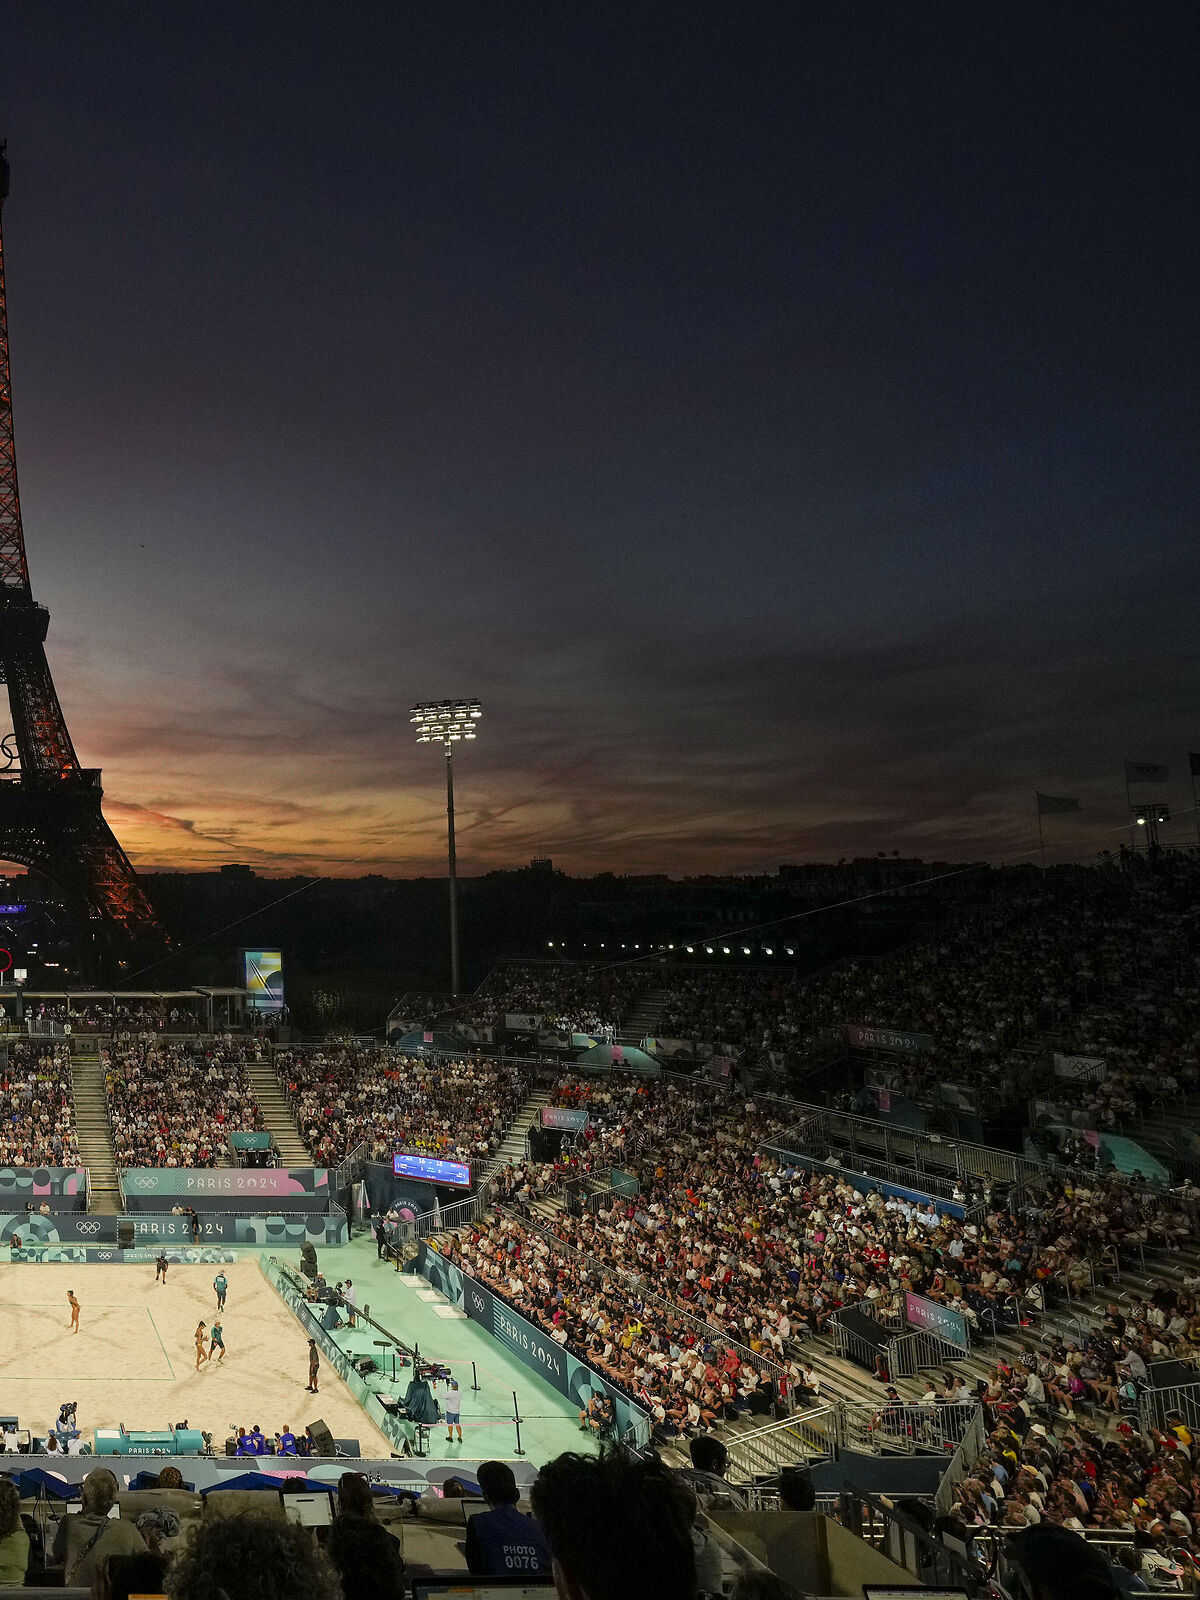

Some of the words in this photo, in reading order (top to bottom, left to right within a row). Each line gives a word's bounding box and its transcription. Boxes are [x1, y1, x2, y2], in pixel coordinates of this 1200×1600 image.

[187, 1178, 231, 1188] PARIS
[237, 1178, 277, 1188] 2024
[133, 1223, 176, 1234] ARIS
[910, 1304, 935, 1321] PARIS
[500, 1315, 528, 1349] PARIS
[531, 1341, 560, 1375] 2024
[503, 1545, 536, 1555] PHOTO
[505, 1555, 539, 1570] 0076
